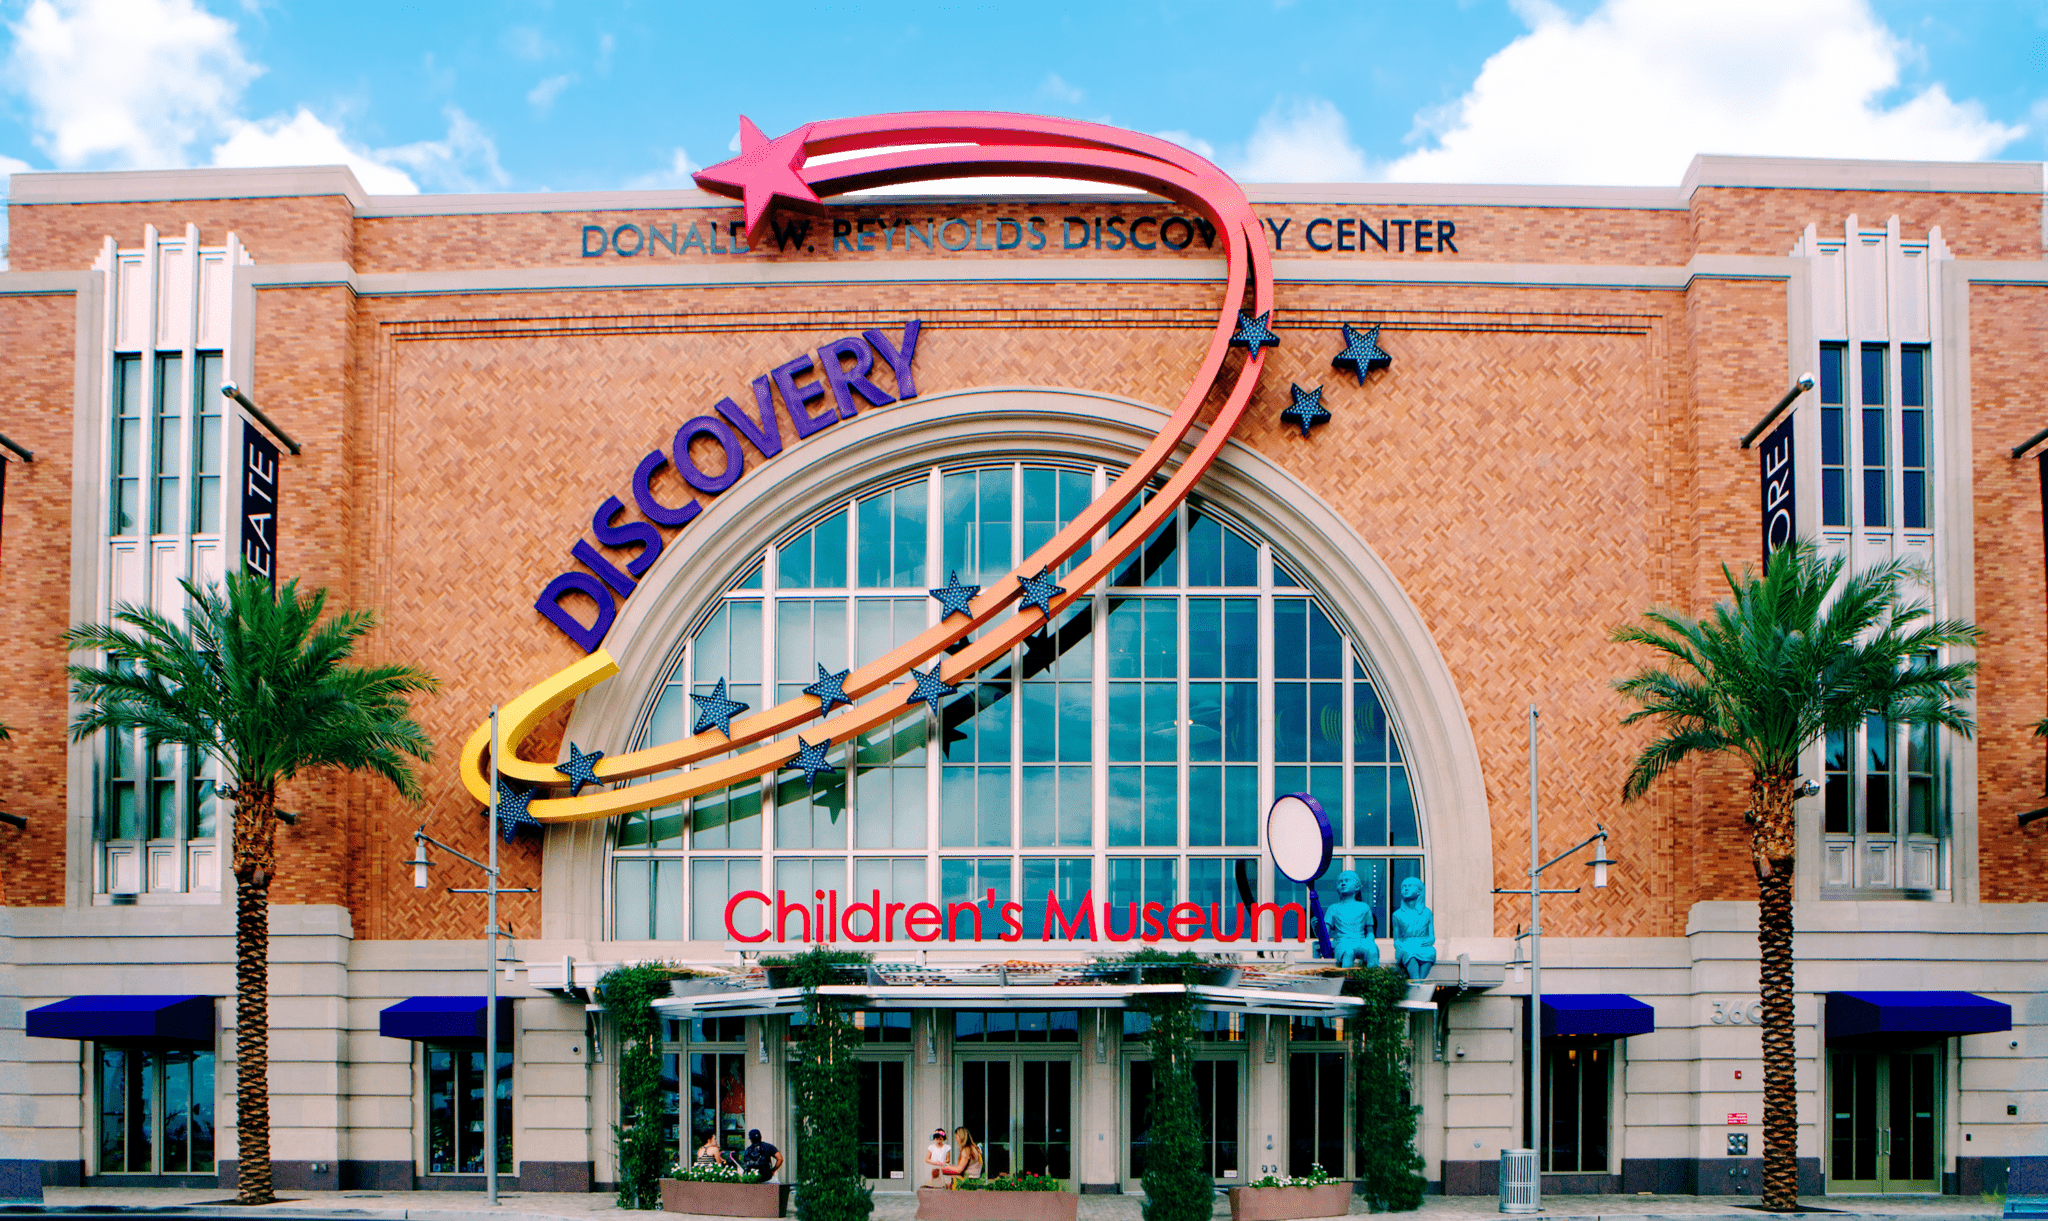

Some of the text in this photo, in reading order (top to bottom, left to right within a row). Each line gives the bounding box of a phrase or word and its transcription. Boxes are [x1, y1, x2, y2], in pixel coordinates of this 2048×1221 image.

[582, 215, 1459, 258] DONALD W. REYNOLDS DISCOVY CENTER
[246, 442, 273, 578] EATE
[534, 319, 921, 653] DISCOVERY
[724, 888, 1305, 943] Children's Museum
